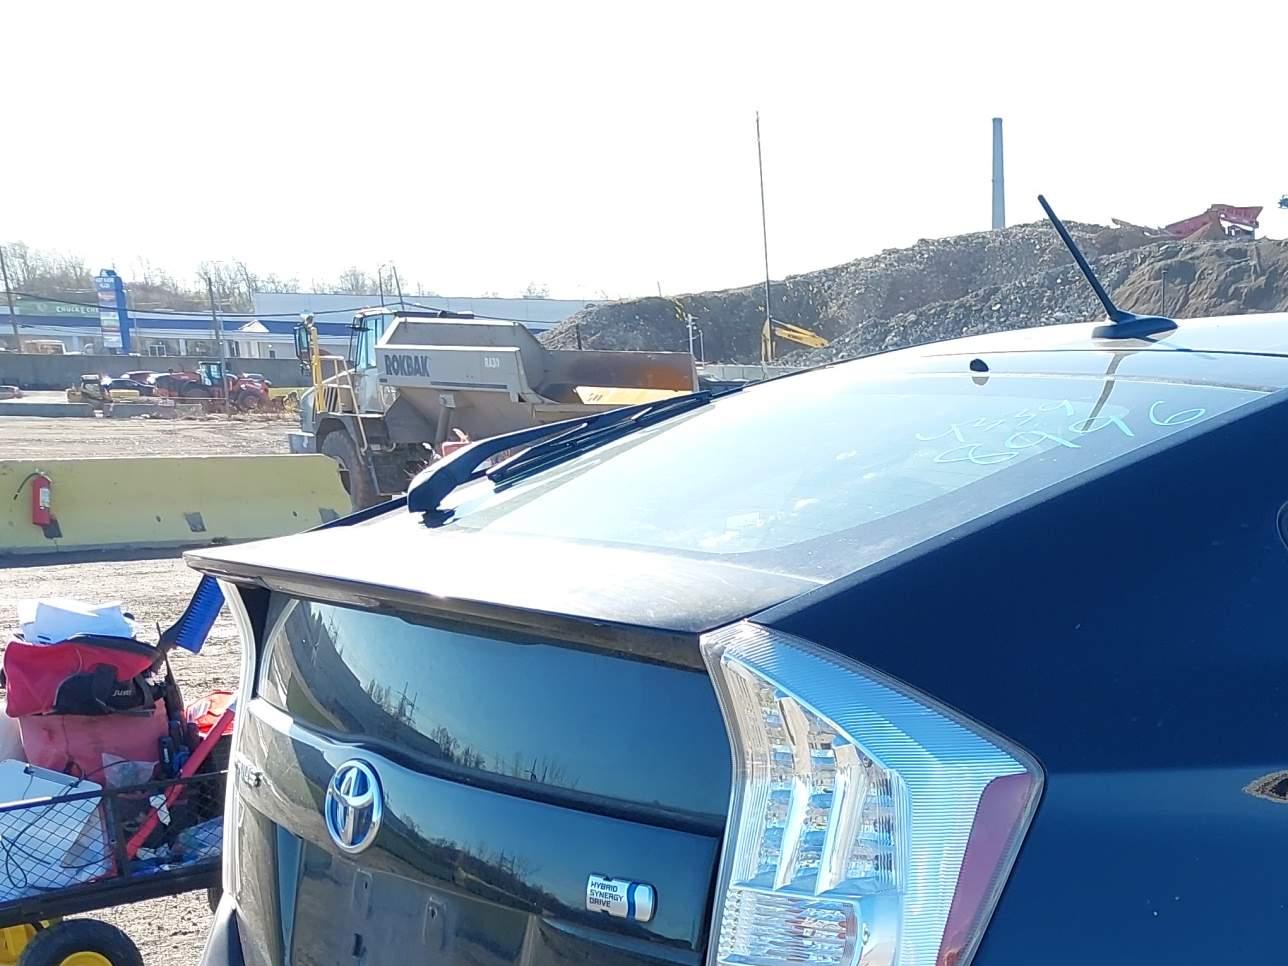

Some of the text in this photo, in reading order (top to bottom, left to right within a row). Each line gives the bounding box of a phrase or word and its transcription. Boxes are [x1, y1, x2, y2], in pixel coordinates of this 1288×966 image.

[384, 354, 430, 377] ROKBAK
[590, 880, 619, 893] HYBRID
[589, 888, 625, 902] SYNERGY
[589, 896, 611, 908] DRIVE
